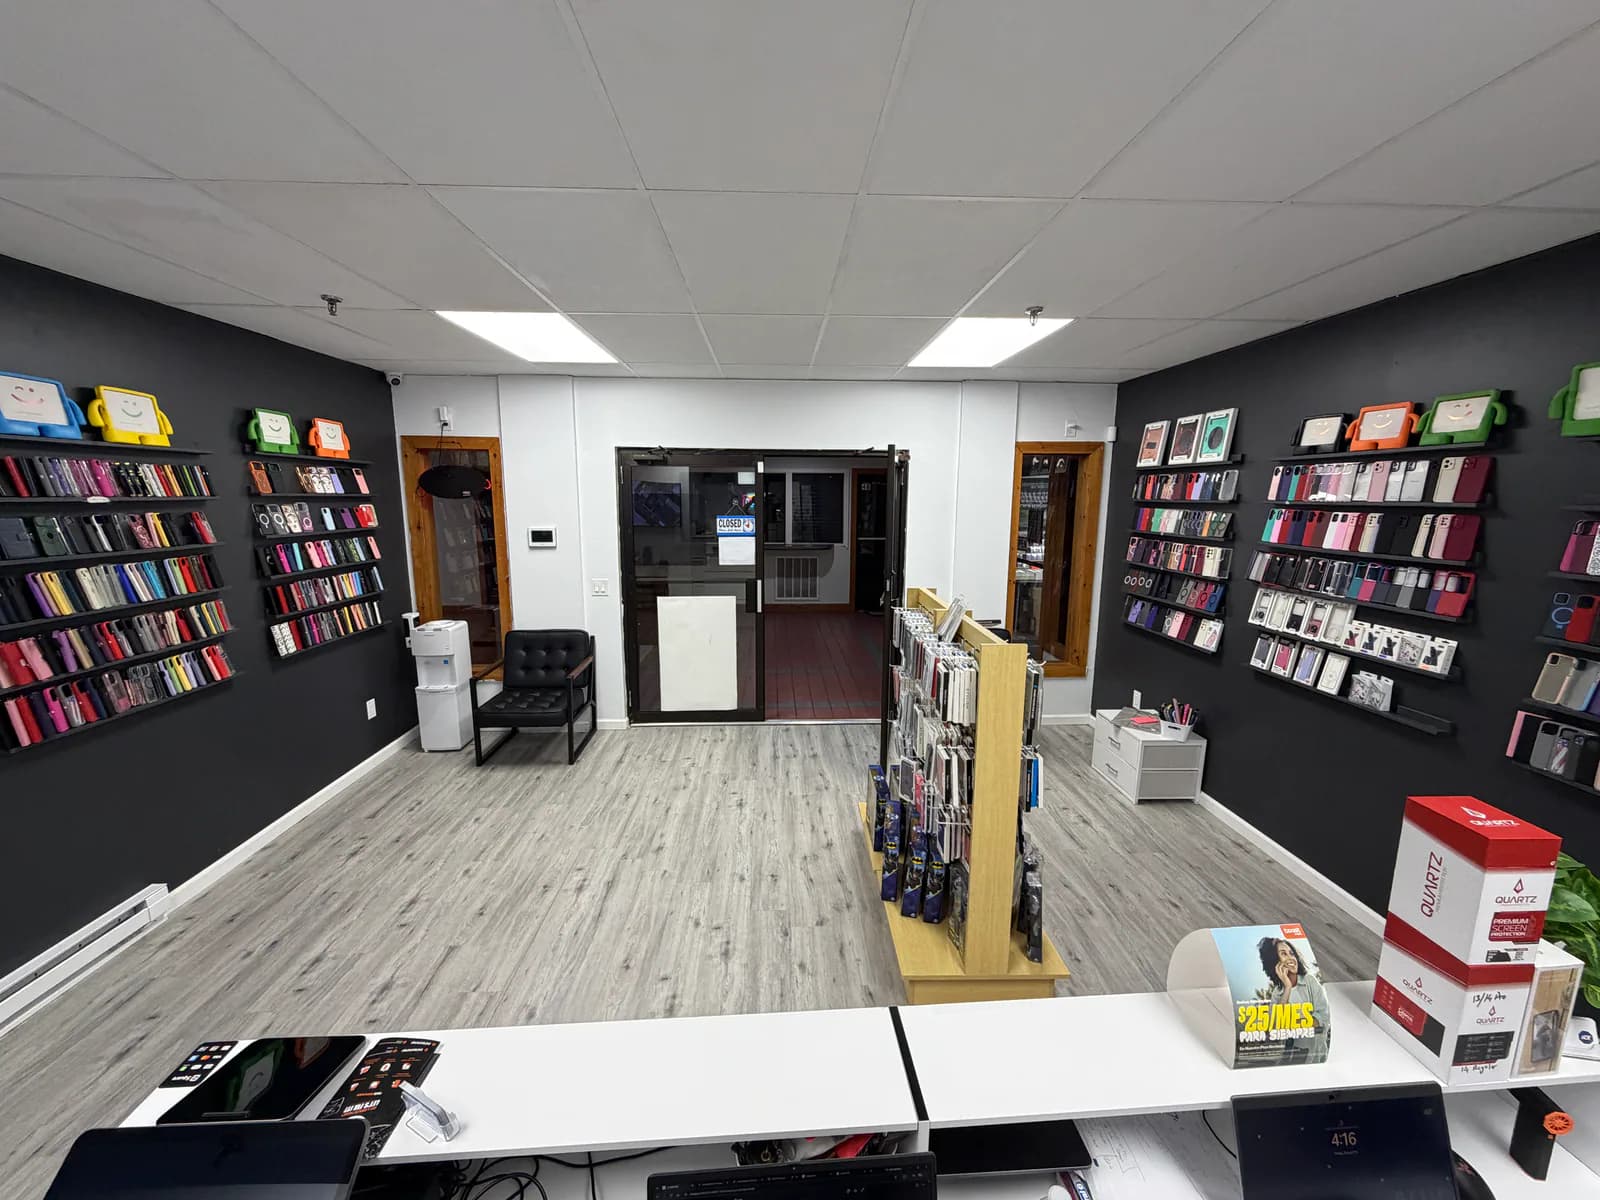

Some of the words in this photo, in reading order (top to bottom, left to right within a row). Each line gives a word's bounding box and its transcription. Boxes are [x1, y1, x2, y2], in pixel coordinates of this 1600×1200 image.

[718, 518, 742, 528] CLOSED
[1420, 851, 1443, 918] QUARTZ
[1495, 896, 1537, 904] QUARTZ
[1492, 924, 1528, 932] SCREEN
[1402, 978, 1433, 1005] QUARTZ
[1238, 1002, 1314, 1032] $25/MES
[1476, 1016, 1505, 1025] QUARTZ
[1239, 1030, 1266, 1043] PARA
[1269, 1027, 1315, 1041] SIEMPRE
[1331, 1131, 1357, 1148] 4:16
